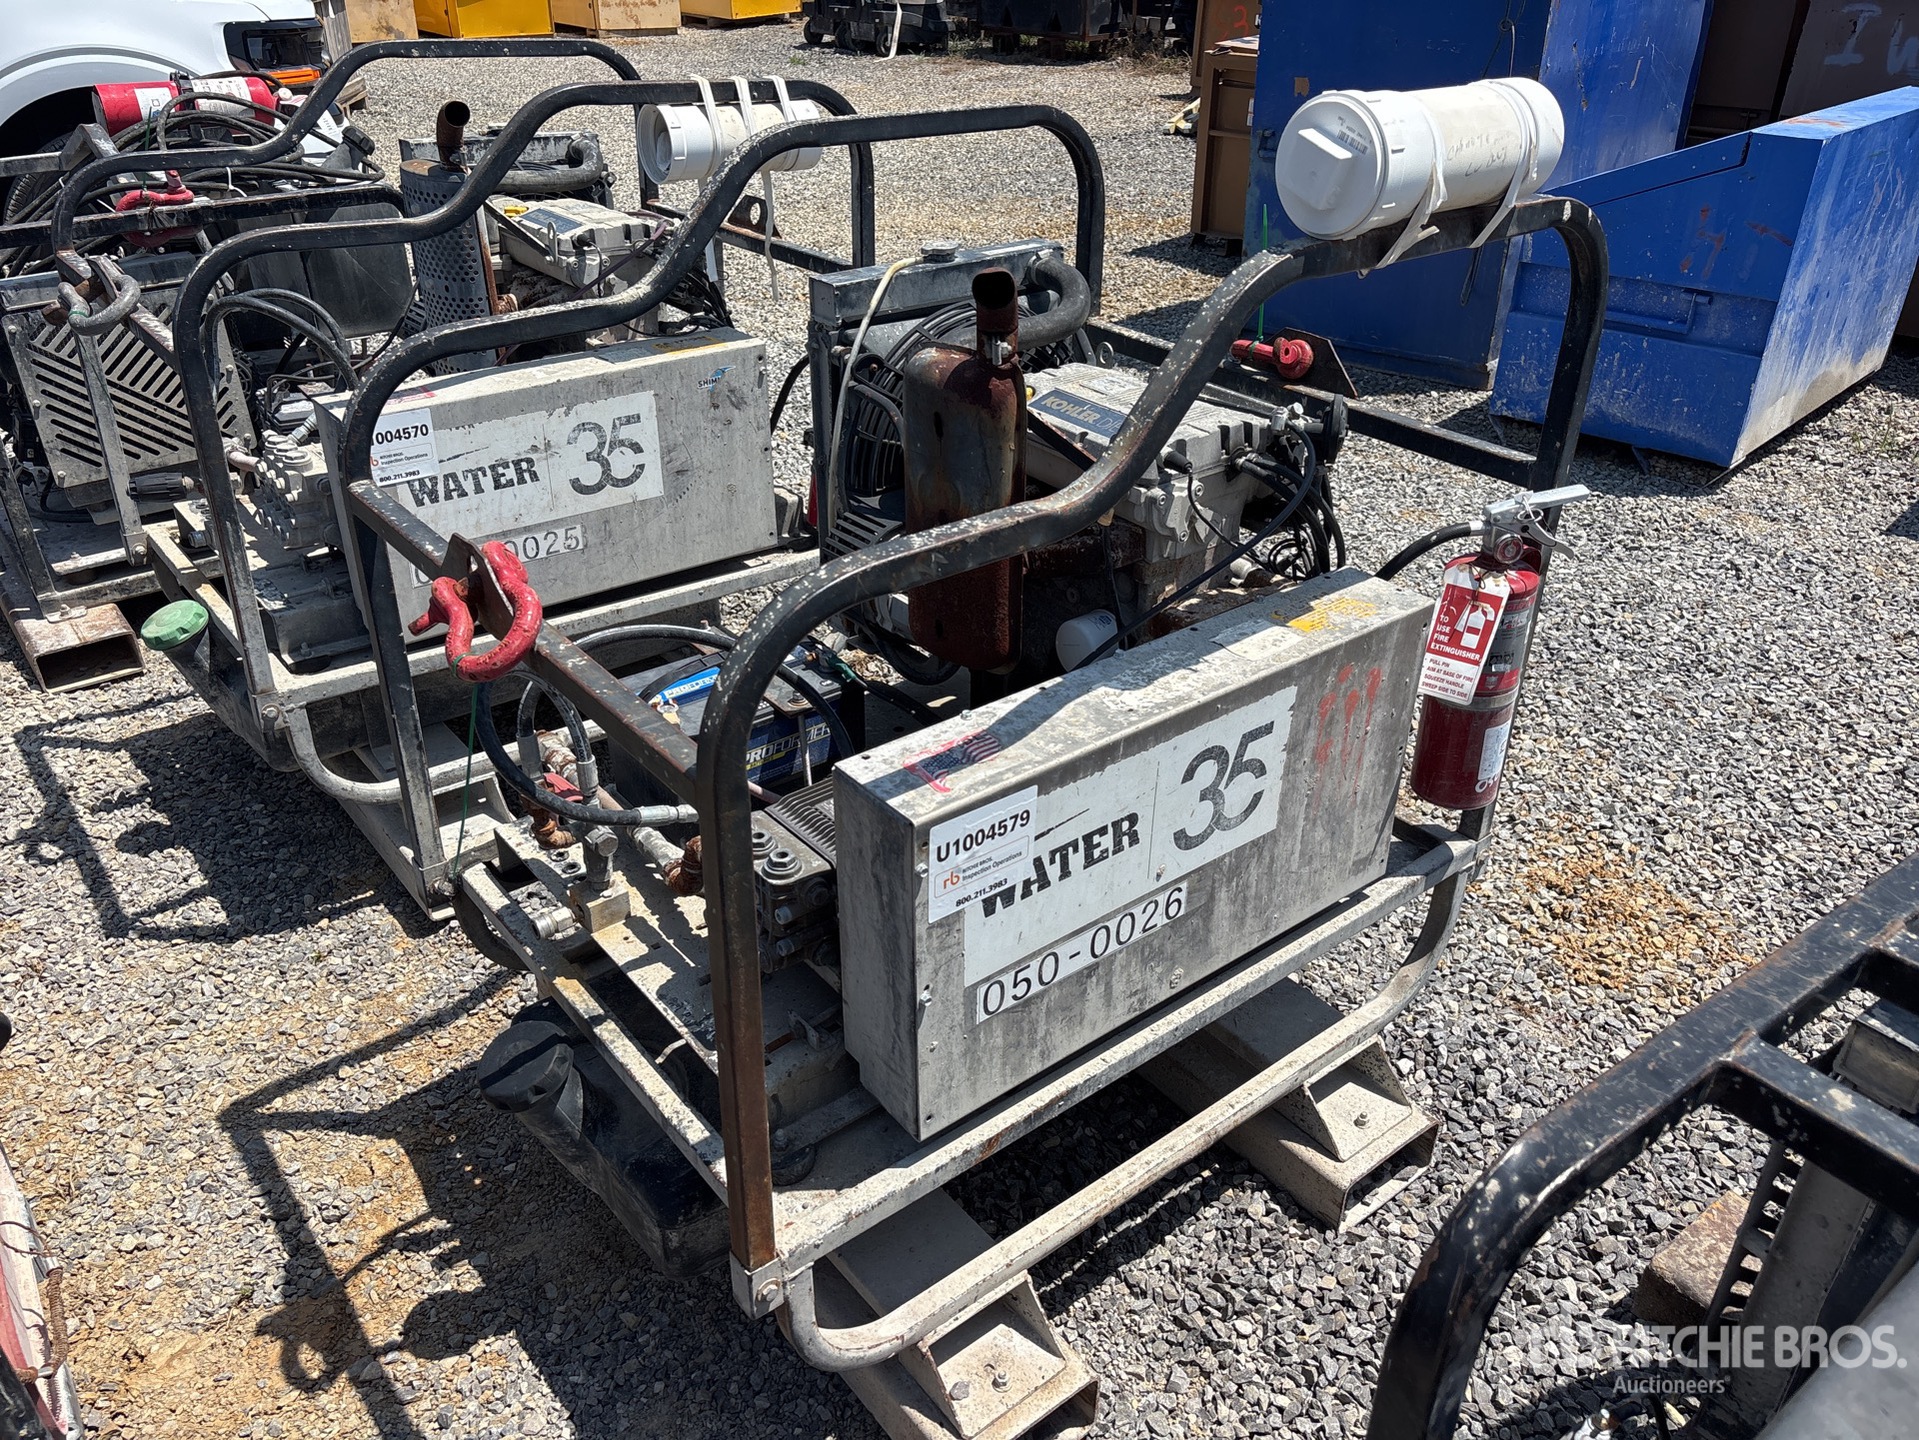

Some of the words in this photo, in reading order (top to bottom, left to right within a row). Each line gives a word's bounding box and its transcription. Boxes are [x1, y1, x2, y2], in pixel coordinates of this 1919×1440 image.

[1041, 396, 1101, 424] KOHLER
[404, 452, 428, 462] Operations
[567, 413, 646, 496] 35
[406, 457, 540, 508] WATER
[1436, 623, 1451, 633] USE
[1439, 614, 1449, 623] TO
[1433, 633, 1450, 643] FIRE
[1429, 658, 1441, 667] PULL
[1421, 681, 1438, 689] SWEEP
[1457, 691, 1468, 699] SIDE
[1424, 673, 1445, 684] SQUEEZE
[1446, 680, 1464, 689] HANDLE
[1443, 670, 1456, 679] BASE
[1463, 675, 1474, 684] FIRE
[1173, 721, 1275, 851] 35
[936, 809, 1031, 863] U1004579
[962, 864, 992, 882] Inspection
[992, 850, 1023, 869] Operations
[981, 812, 1141, 918] WATER
[955, 878, 1008, 907] 800.211.3983
[982, 886, 1184, 1016] 050-0026
